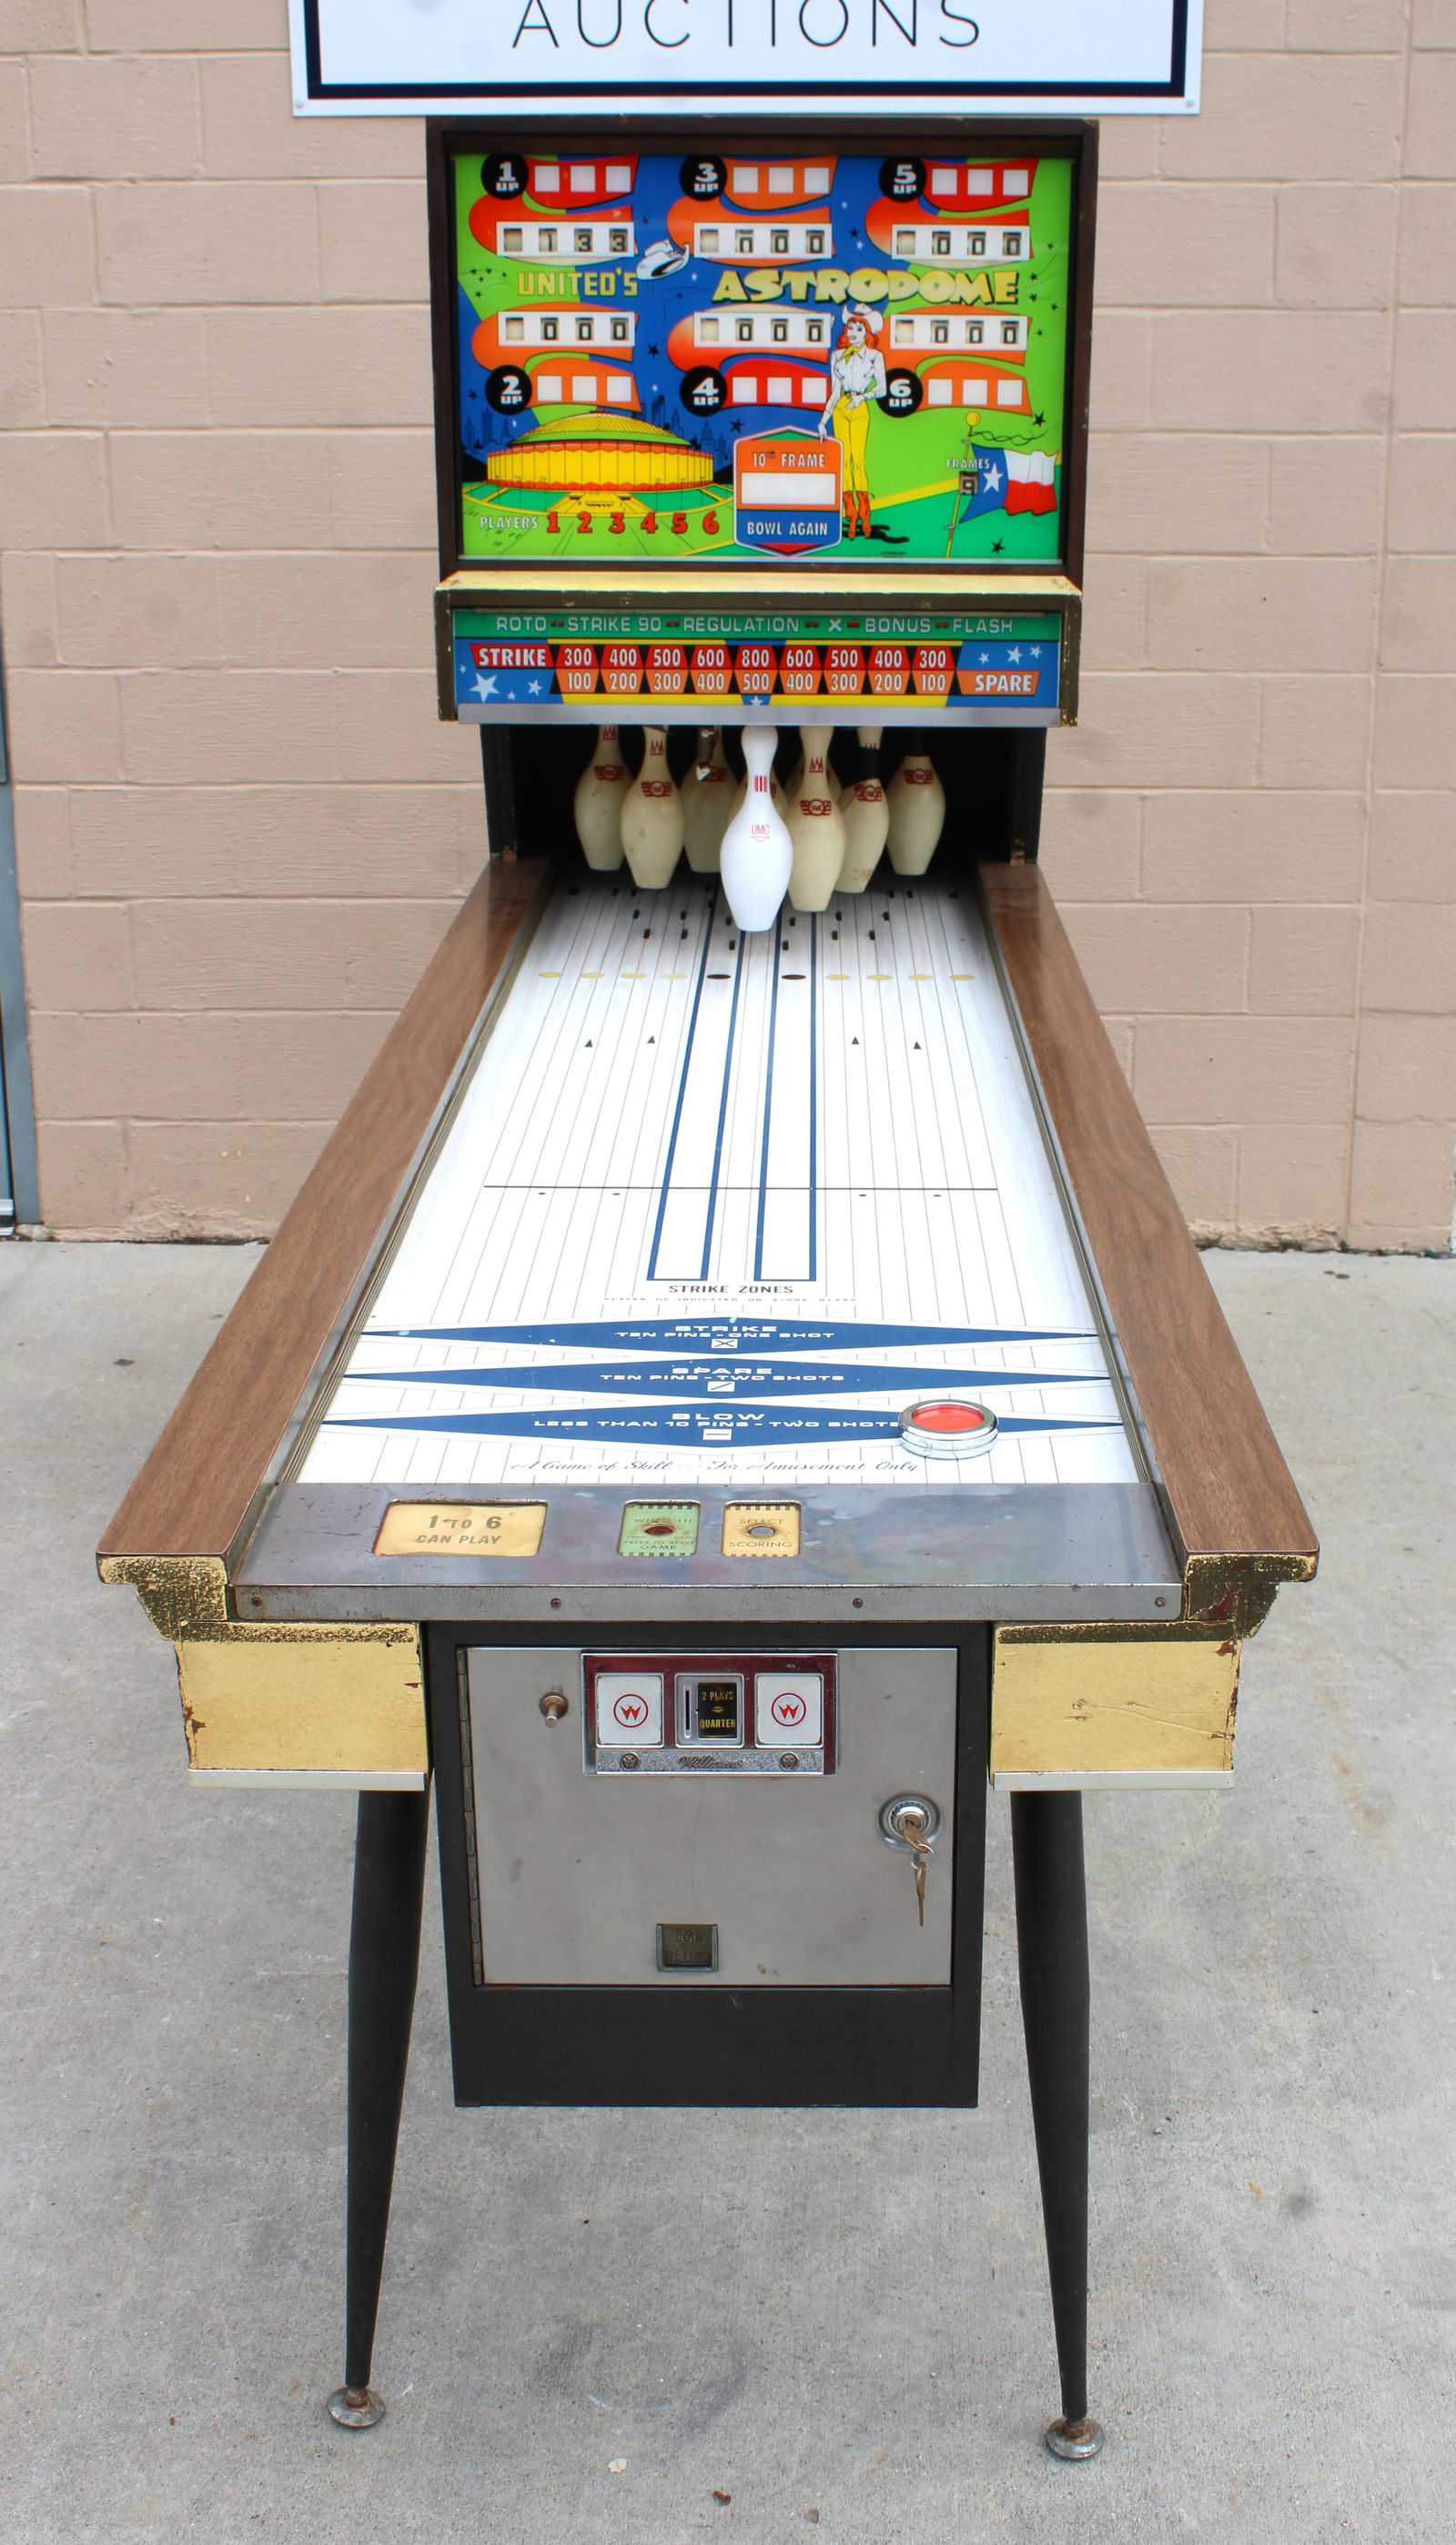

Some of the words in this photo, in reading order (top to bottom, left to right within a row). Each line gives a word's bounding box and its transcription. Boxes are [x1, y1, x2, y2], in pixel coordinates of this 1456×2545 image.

[498, 161, 517, 182] 1
[693, 163, 719, 183] 3
[893, 164, 917, 184] 5
[496, 182, 520, 192] UP
[693, 183, 719, 193] UP
[893, 184, 917, 194] UP
[518, 267, 638, 296] UNITED'S
[712, 268, 1020, 305] ASTRODOME
[501, 375, 521, 395] 2
[692, 377, 719, 396] 4
[889, 379, 912, 398] 6
[500, 395, 523, 405] UP
[693, 396, 720, 406] UP
[888, 398, 913, 408] UP
[781, 452, 825, 468] FRAME
[945, 458, 990, 470] FRAMES
[480, 516, 540, 530] PLAYERS
[546, 512, 561, 534] 1
[577, 512, 593, 534] 2
[609, 512, 625, 534] 3
[641, 512, 659, 534] 4
[671, 512, 689, 534] 5
[703, 511, 720, 534] 6
[746, 522, 783, 536] BOWL
[789, 522, 828, 536] AGAIN
[496, 616, 547, 632] ROTO
[567, 617, 632, 633] STRIKE
[638, 617, 662, 633] 90
[683, 617, 800, 633] REGULATION
[865, 618, 932, 634] BONUS
[953, 618, 1014, 634] FLASH
[479, 648, 547, 667] STRIKE
[563, 648, 592, 665] 300
[609, 648, 637, 666] 400
[652, 648, 681, 666] 500
[696, 648, 724, 666] 600
[742, 648, 770, 667] 800
[786, 649, 814, 667] 600
[830, 649, 858, 667] 500
[875, 649, 903, 667] 400
[919, 650, 946, 667] 300
[567, 672, 592, 690] 100
[609, 672, 638, 690] 200
[653, 672, 681, 690] 300
[697, 673, 724, 690] 400
[743, 673, 770, 691] 500
[786, 674, 814, 691] 400
[830, 674, 858, 691] 300
[874, 674, 902, 691] 200
[920, 674, 946, 691] 100
[975, 674, 1032, 693] SPARE
[751, 824, 770, 836] UMC
[669, 1285, 729, 1293] STRIKE
[738, 1285, 794, 1294] ZONES
[672, 1413, 766, 1421] BLOW
[542, 1460, 592, 1470] Game
[598, 1461, 620, 1471] of
[624, 1460, 673, 1470] Skill
[707, 1460, 739, 1470] For
[746, 1461, 865, 1470] Amusement
[875, 1461, 918, 1472] Only
[430, 1515, 439, 1528] 1
[441, 1518, 472, 1528] TO
[486, 1516, 502, 1529] 6
[416, 1535, 451, 1544] CAN
[459, 1536, 502, 1545] PLAY
[702, 1691, 707, 1700] 2
[700, 1719, 736, 1729] QUARTER
